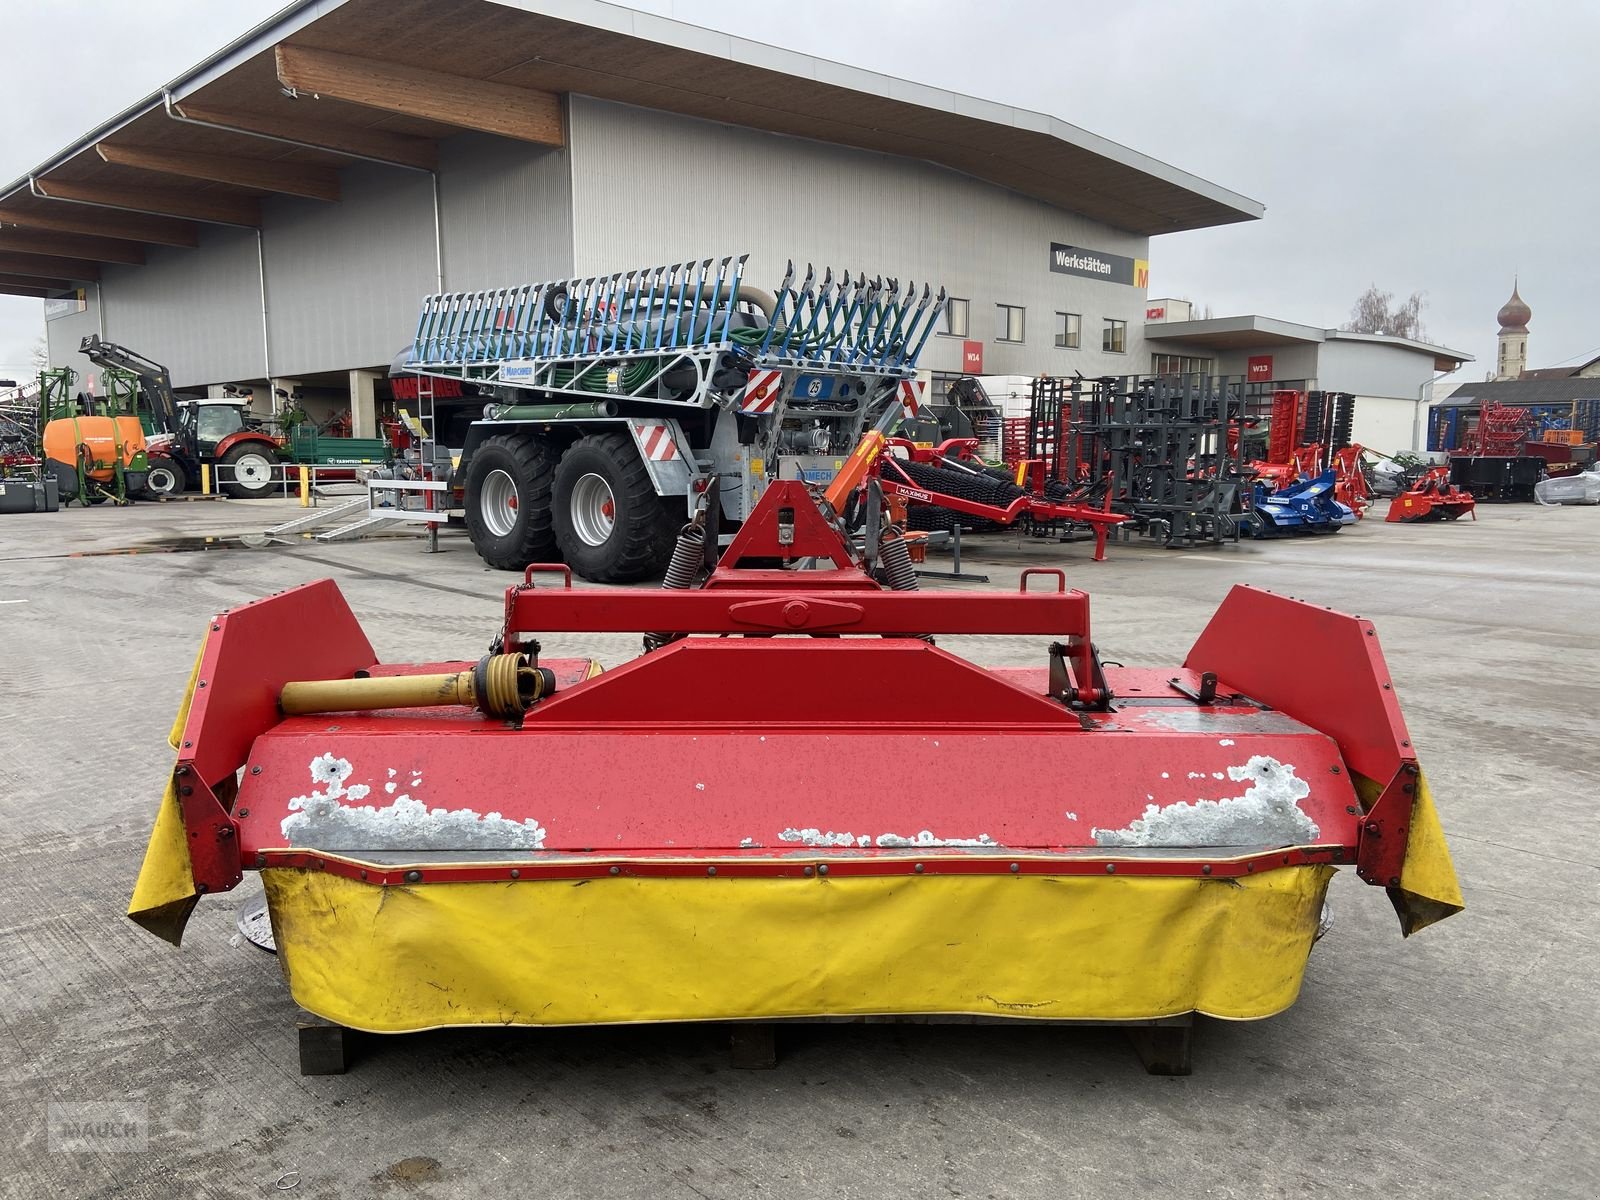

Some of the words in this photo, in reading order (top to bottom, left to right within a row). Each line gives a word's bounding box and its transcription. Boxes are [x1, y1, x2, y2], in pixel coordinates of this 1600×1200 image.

[1056, 251, 1111, 274] Werkstätten
[967, 353, 980, 361] W14
[810, 382, 821, 393] 25
[900, 488, 929, 500] MAXIMUS
